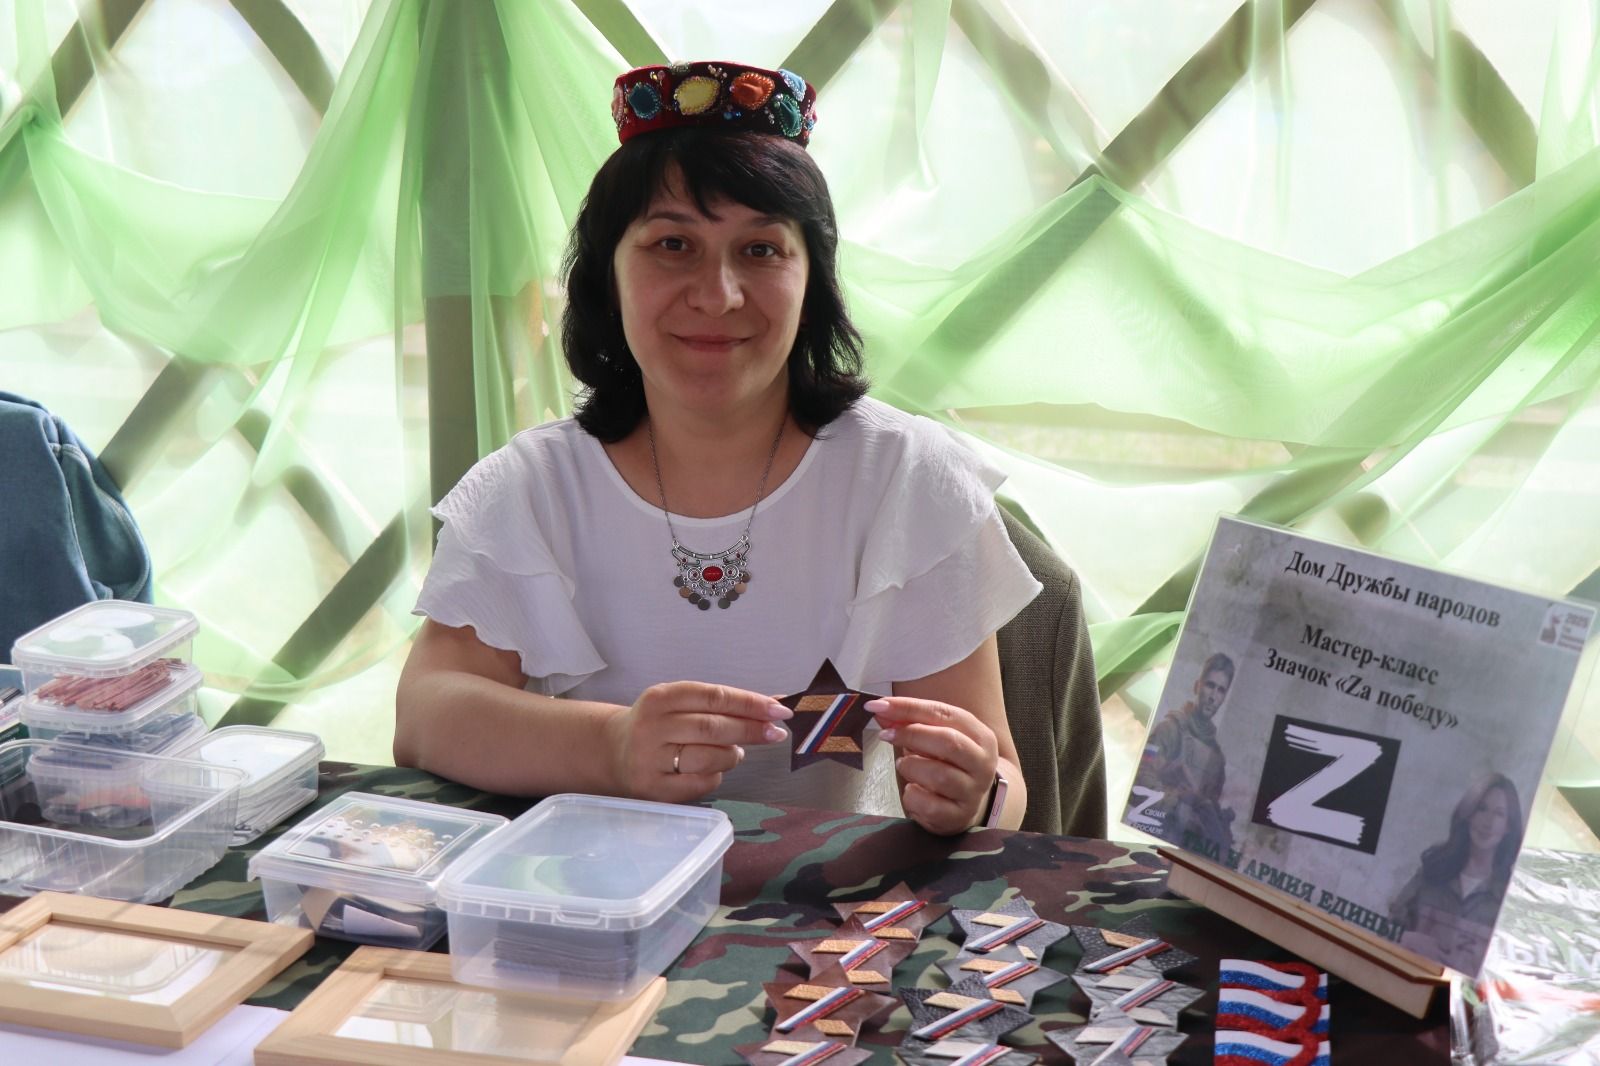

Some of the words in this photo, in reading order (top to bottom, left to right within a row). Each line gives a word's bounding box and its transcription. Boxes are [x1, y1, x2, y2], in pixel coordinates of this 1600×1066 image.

[1285, 551, 1326, 579] Дом
[1326, 562, 1411, 603] Дружбы
[1415, 591, 1501, 628] народов
[1264, 648, 1332, 688] Значок
[1376, 691, 1459, 730] победу»
[1300, 624, 1439, 686] Мастер-класс
[1266, 723, 1382, 845] Z
[1243, 858, 1316, 903] АРМИЯ
